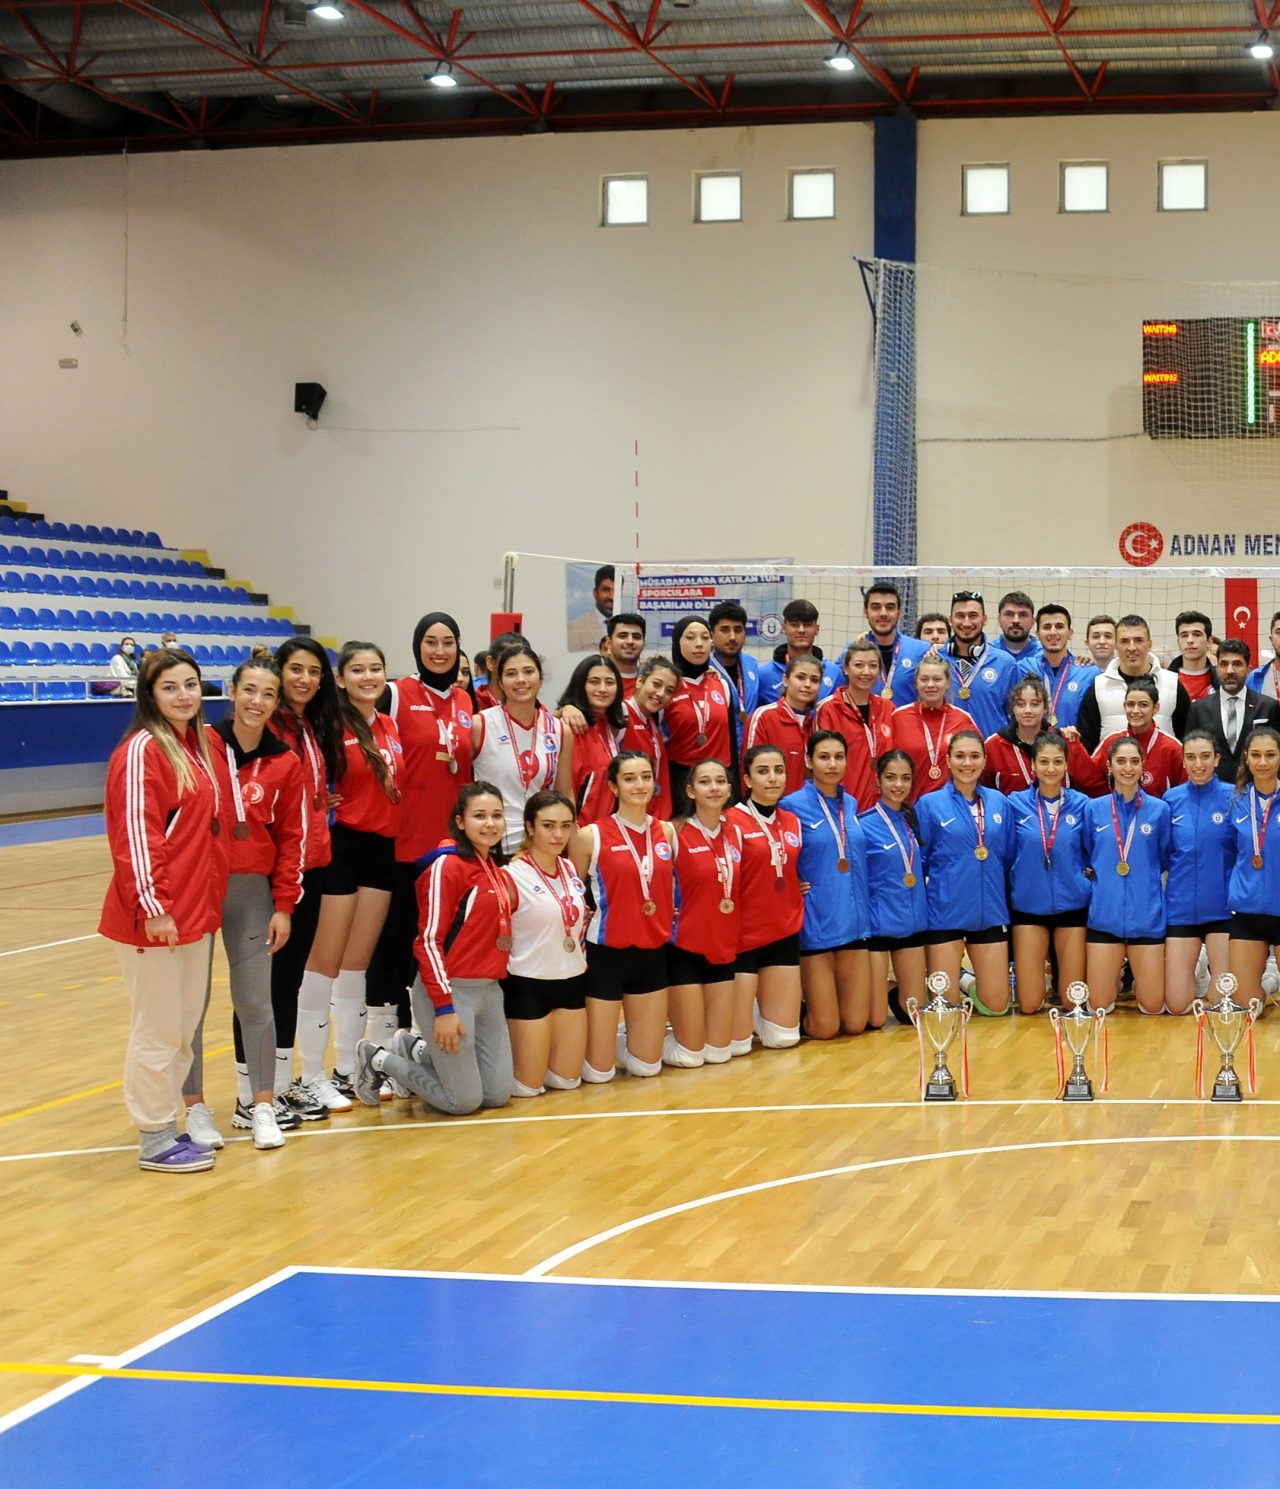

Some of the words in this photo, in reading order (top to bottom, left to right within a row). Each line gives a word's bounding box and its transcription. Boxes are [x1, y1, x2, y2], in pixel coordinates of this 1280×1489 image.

[1170, 534, 1235, 555] ADNAN
[719, 575, 758, 585] KATILAN
[641, 589, 703, 598] SPORCULARA
[640, 601, 693, 611] BAŞARILAR
